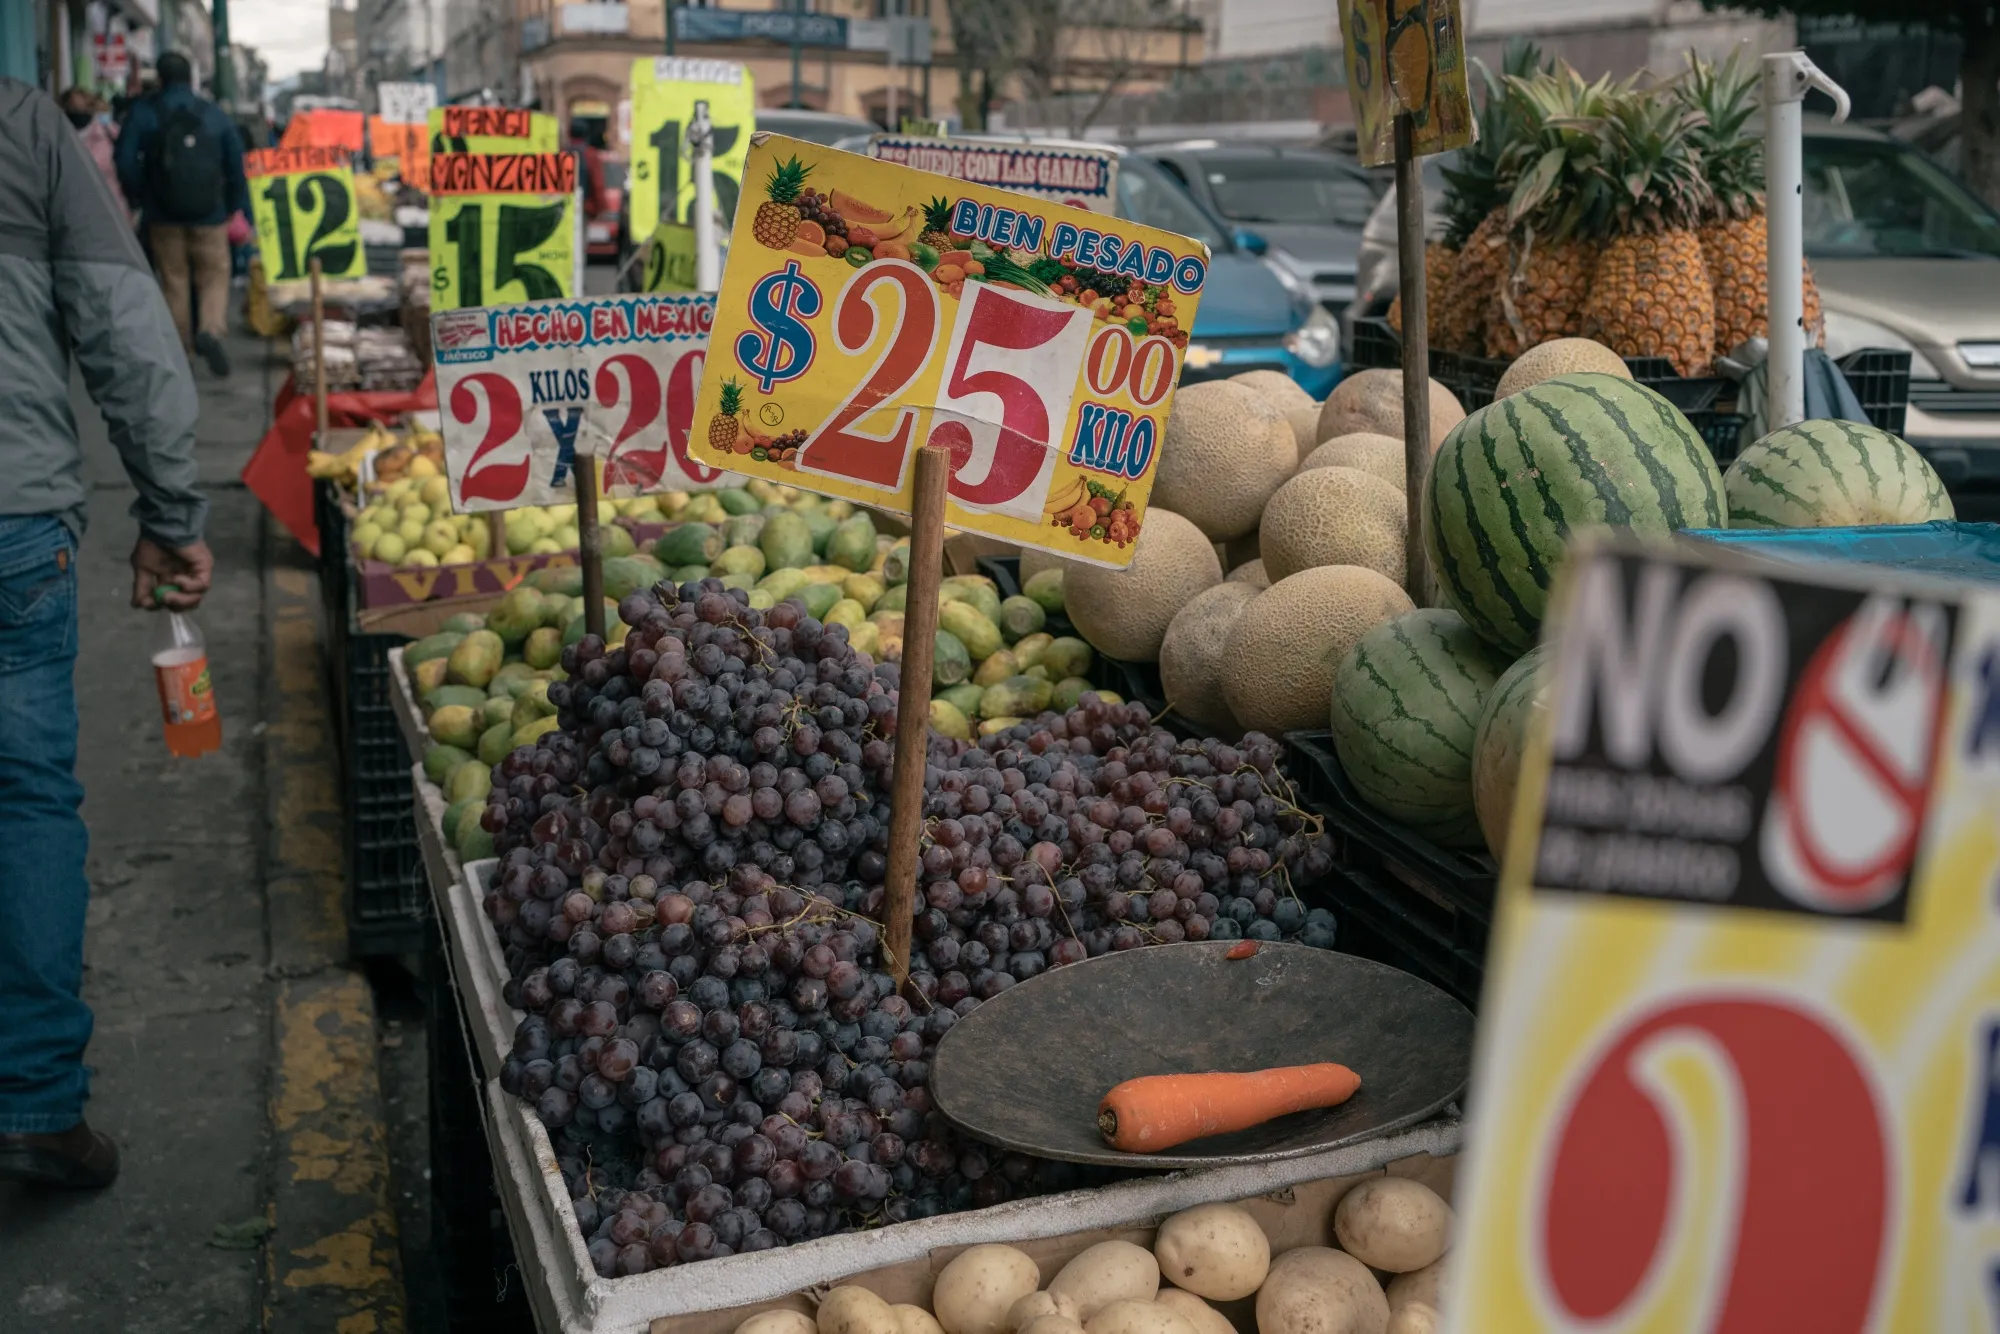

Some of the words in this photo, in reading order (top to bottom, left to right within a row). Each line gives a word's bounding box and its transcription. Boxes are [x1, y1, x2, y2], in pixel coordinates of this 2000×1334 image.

[432, 152, 575, 192] MANZANA
[908, 147, 965, 178] QUEDE
[965, 153, 1000, 182] CON
[1002, 154, 1036, 184] LAS
[264, 174, 357, 280] 12
[953, 199, 1045, 252] BIEN
[1052, 224, 1207, 294] PESADO
[497, 311, 585, 347] HECHO
[592, 308, 631, 339] EN
[637, 303, 713, 335] MEXIC
[450, 373, 531, 506] 2
[529, 368, 590, 404] KILOS
[1068, 402, 1157, 480] KILO
[1548, 558, 1788, 782] NO
